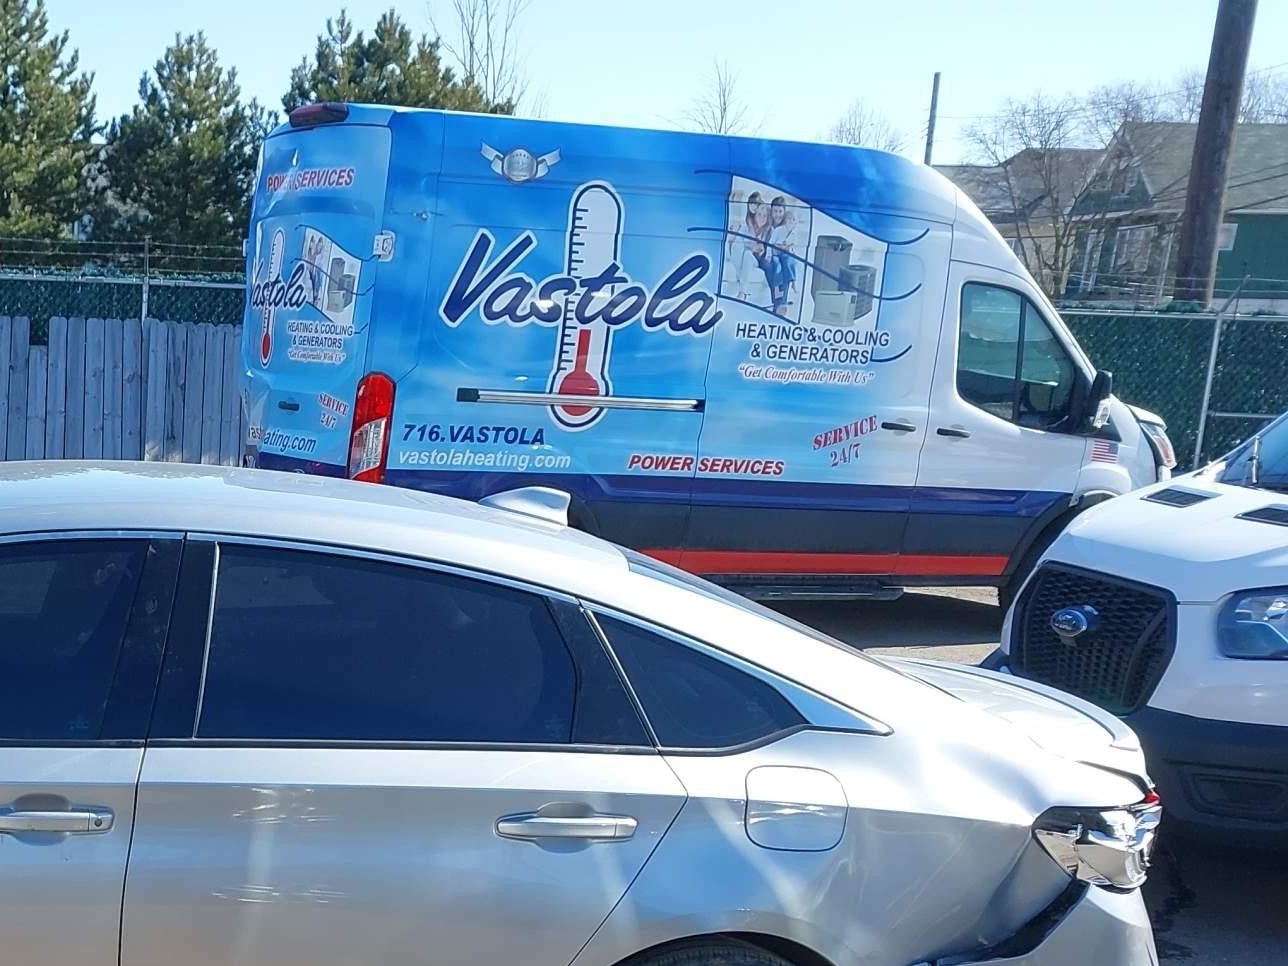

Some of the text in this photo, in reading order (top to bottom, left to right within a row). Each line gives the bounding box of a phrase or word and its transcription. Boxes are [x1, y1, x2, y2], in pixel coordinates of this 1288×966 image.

[294, 168, 355, 190] SERVICES
[442, 231, 724, 335] Vastola
[288, 322, 313, 333] HEATING
[320, 324, 353, 336] COOLING
[735, 323, 889, 347] HEATING & COOLING
[298, 335, 343, 349] GENERATORS
[751, 343, 869, 364] & GENERATORS
[764, 366, 826, 383] Comfortable
[827, 370, 851, 383] With
[319, 392, 349, 416] SERVICE
[402, 423, 546, 446] 716.VASTOLA
[813, 415, 878, 450] SERVICE
[398, 448, 571, 471] vastolaheating.com
[627, 454, 785, 475] POWER SERVICES
[830, 442, 862, 467] 24/7
